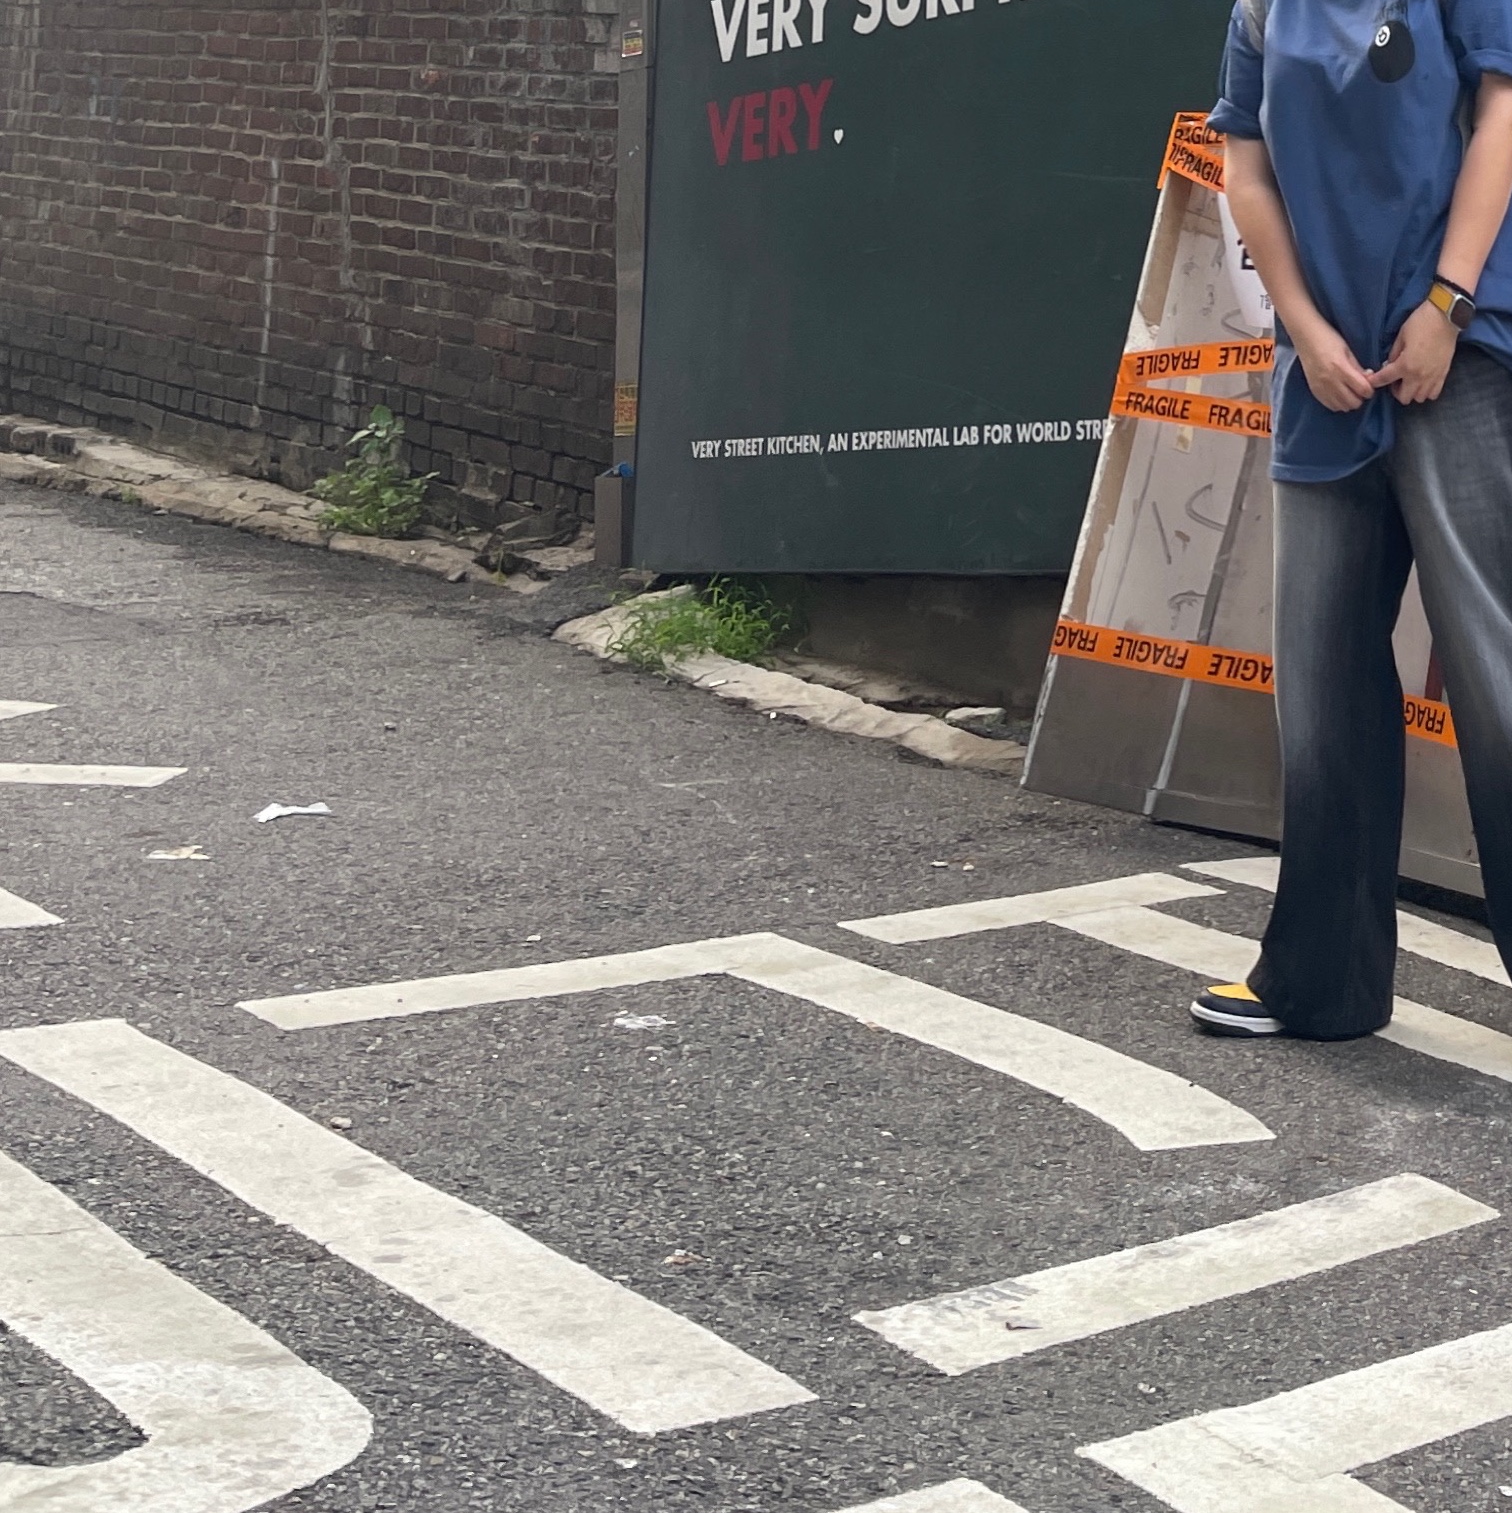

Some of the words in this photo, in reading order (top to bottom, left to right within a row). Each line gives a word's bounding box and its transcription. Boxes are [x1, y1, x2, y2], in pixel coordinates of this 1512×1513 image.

[1136, 349, 1201, 377] FRAGILE
[1126, 391, 1191, 422] FRAGILE
[691, 440, 721, 460] VERY
[724, 437, 764, 458] STREET
[767, 434, 823, 456] KITCHEN,
[827, 433, 848, 452] AN
[852, 428, 949, 451] EXPERIMENTAL
[953, 425, 979, 446] LAB
[983, 423, 1012, 445] FOR
[1016, 421, 1071, 443] WORLD
[1113, 634, 1190, 670] FRAGILE
